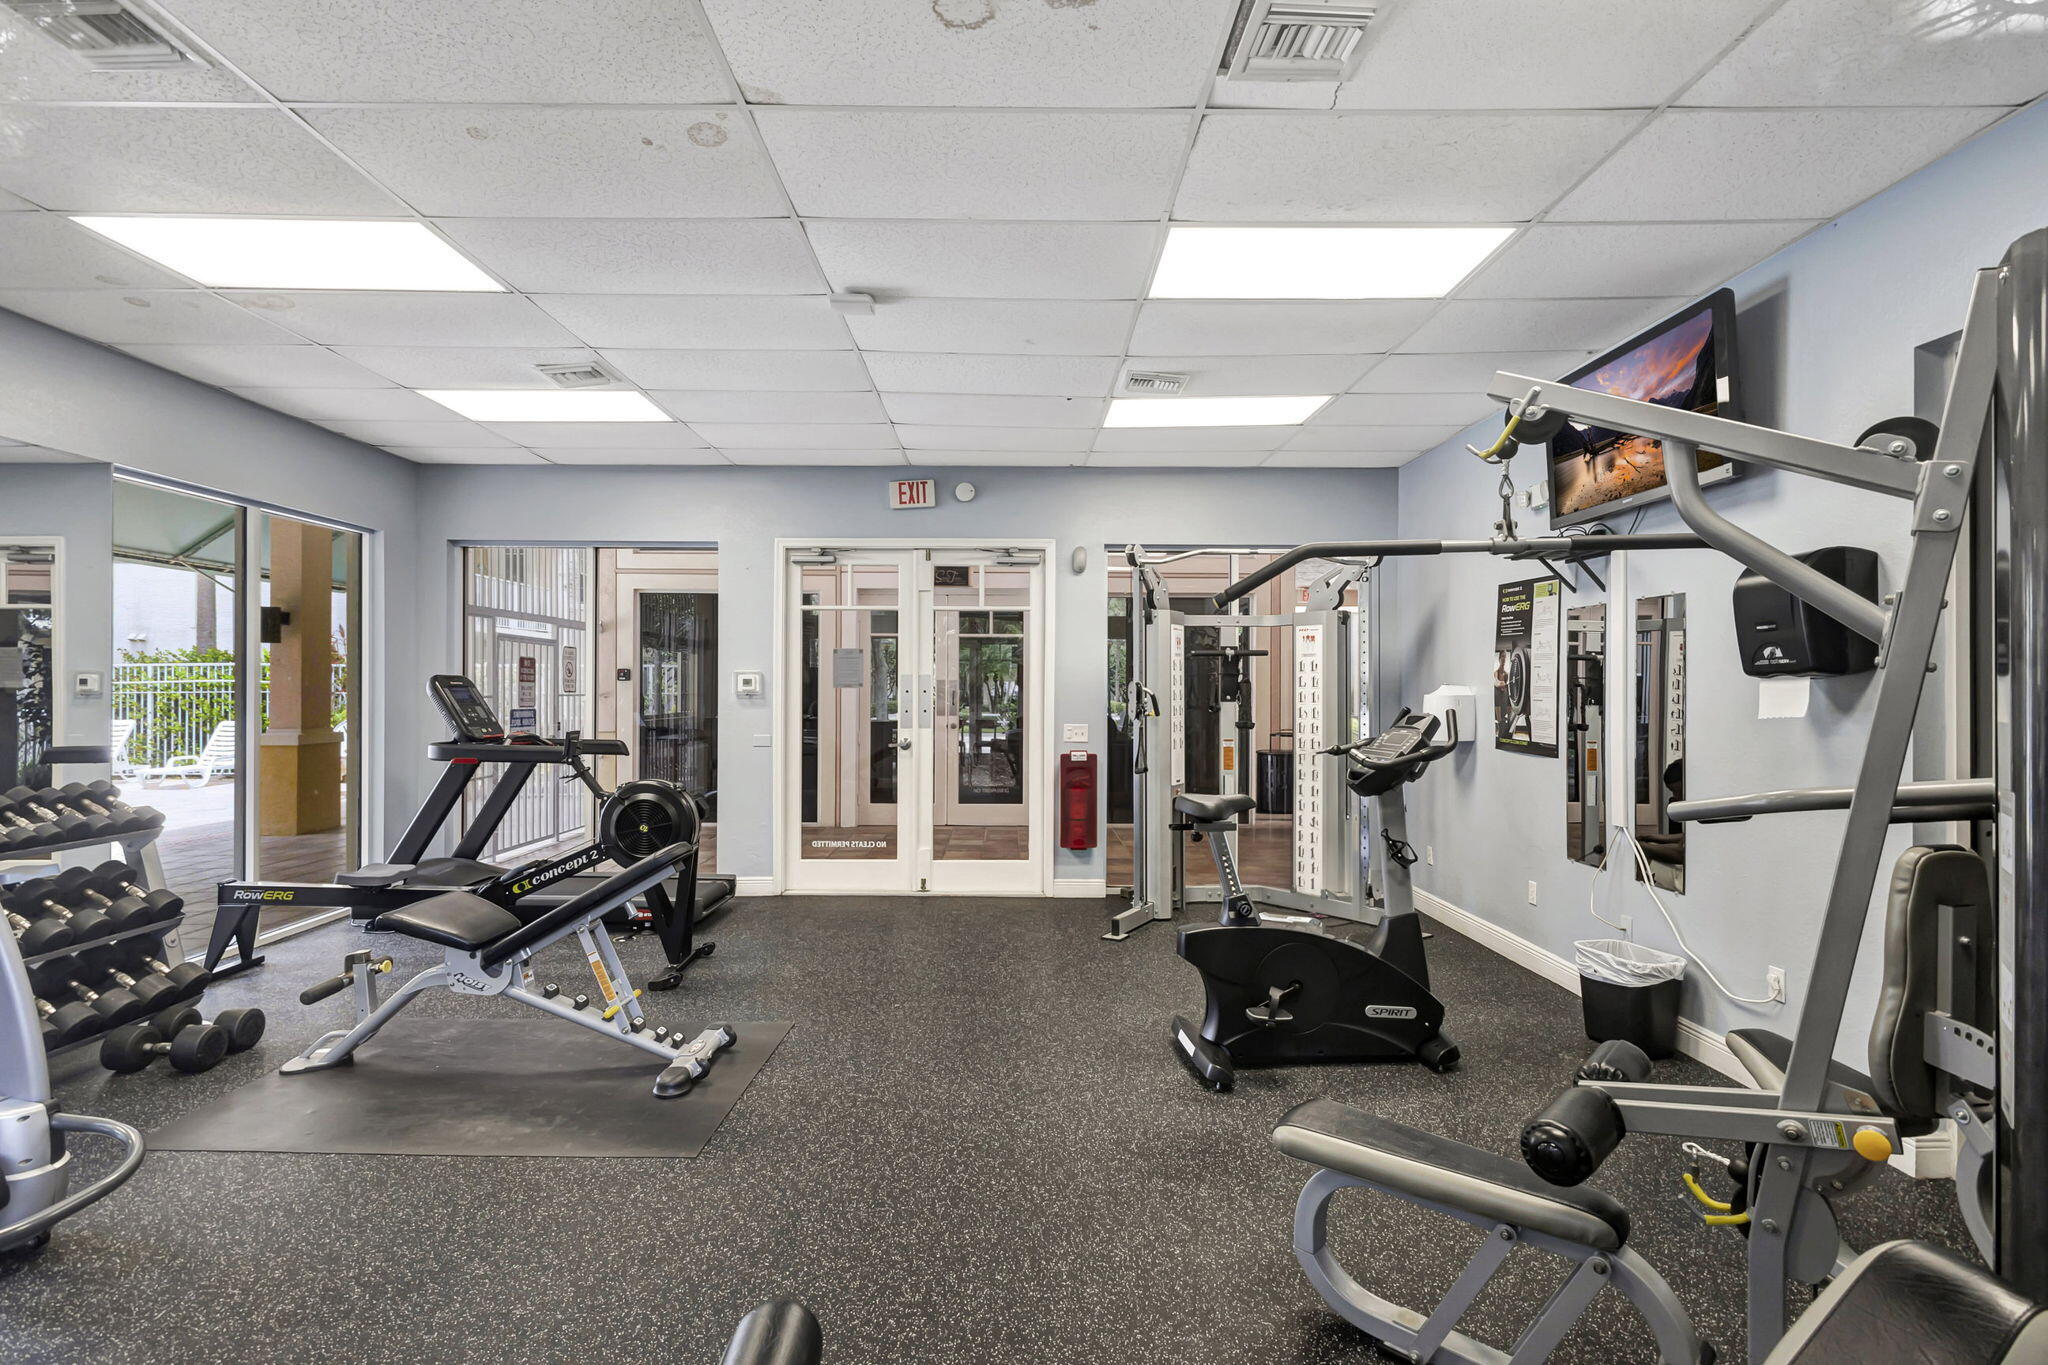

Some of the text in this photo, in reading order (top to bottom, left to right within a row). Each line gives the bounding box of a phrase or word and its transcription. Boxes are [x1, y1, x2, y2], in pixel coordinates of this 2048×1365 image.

[898, 481, 928, 505] EXIT
[1501, 601, 1531, 613] RowERG
[532, 850, 599, 886] concept 2
[233, 889, 295, 901] RowERG
[453, 972, 492, 992] HOIST
[1370, 1008, 1413, 1017] SPIRIT
